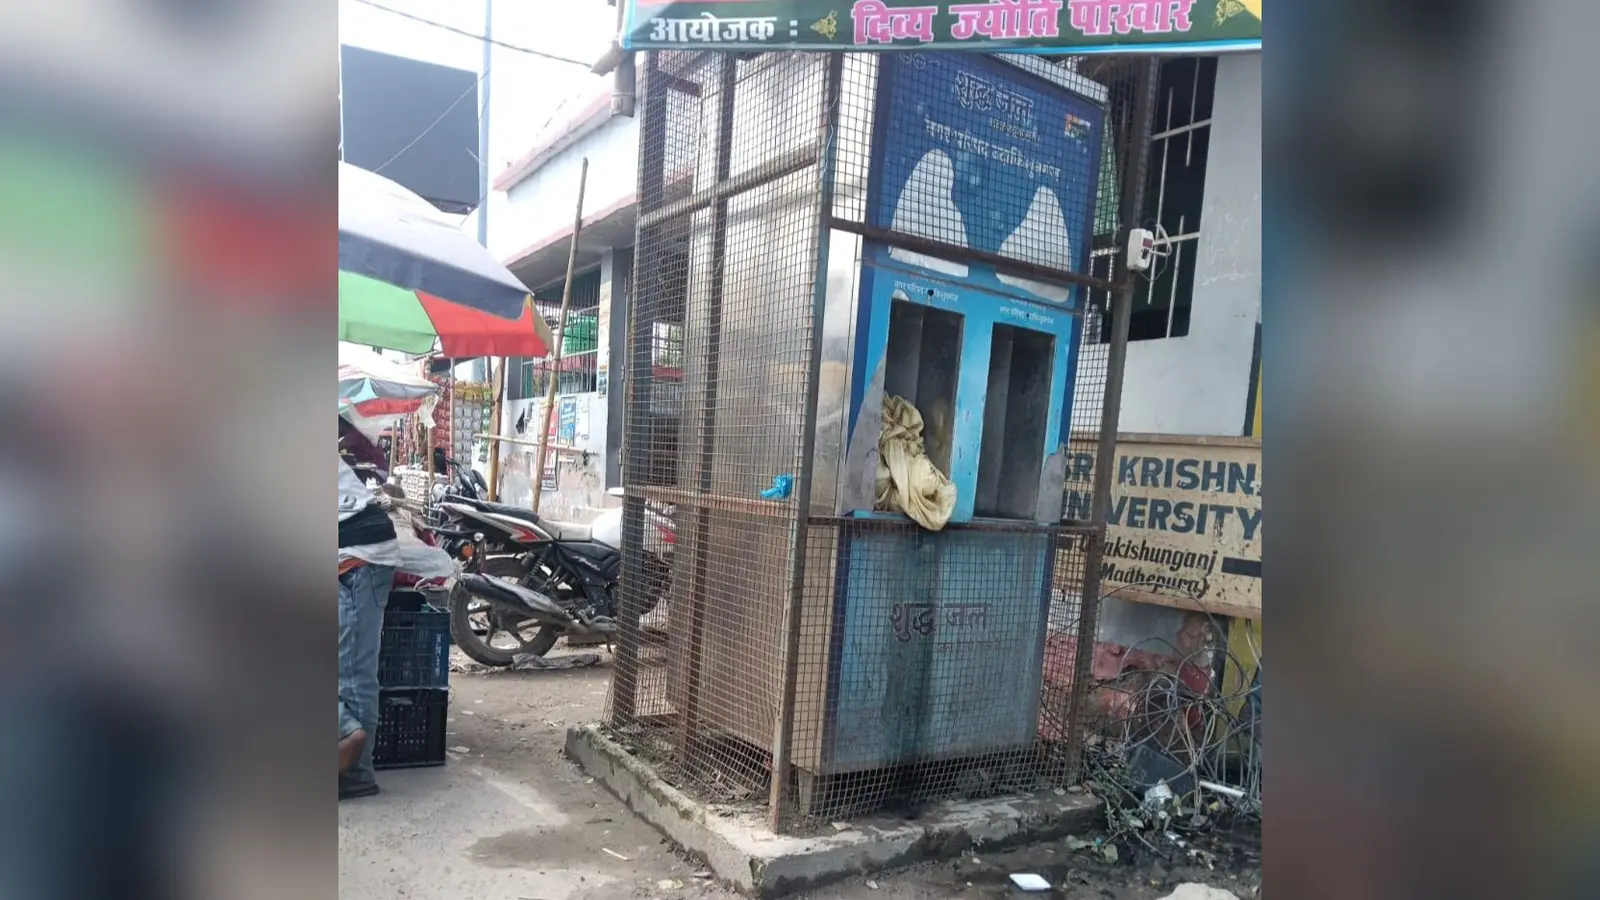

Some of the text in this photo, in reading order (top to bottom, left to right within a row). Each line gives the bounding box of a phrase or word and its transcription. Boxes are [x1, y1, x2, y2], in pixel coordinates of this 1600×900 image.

[650, 12, 777, 42] आयोजक
[851, 0, 938, 44] दिव्य
[1117, 456, 1261, 497] KRISHN
[1060, 489, 1262, 541] NVERSITY
[888, 602, 992, 643] शुद्ध जल
